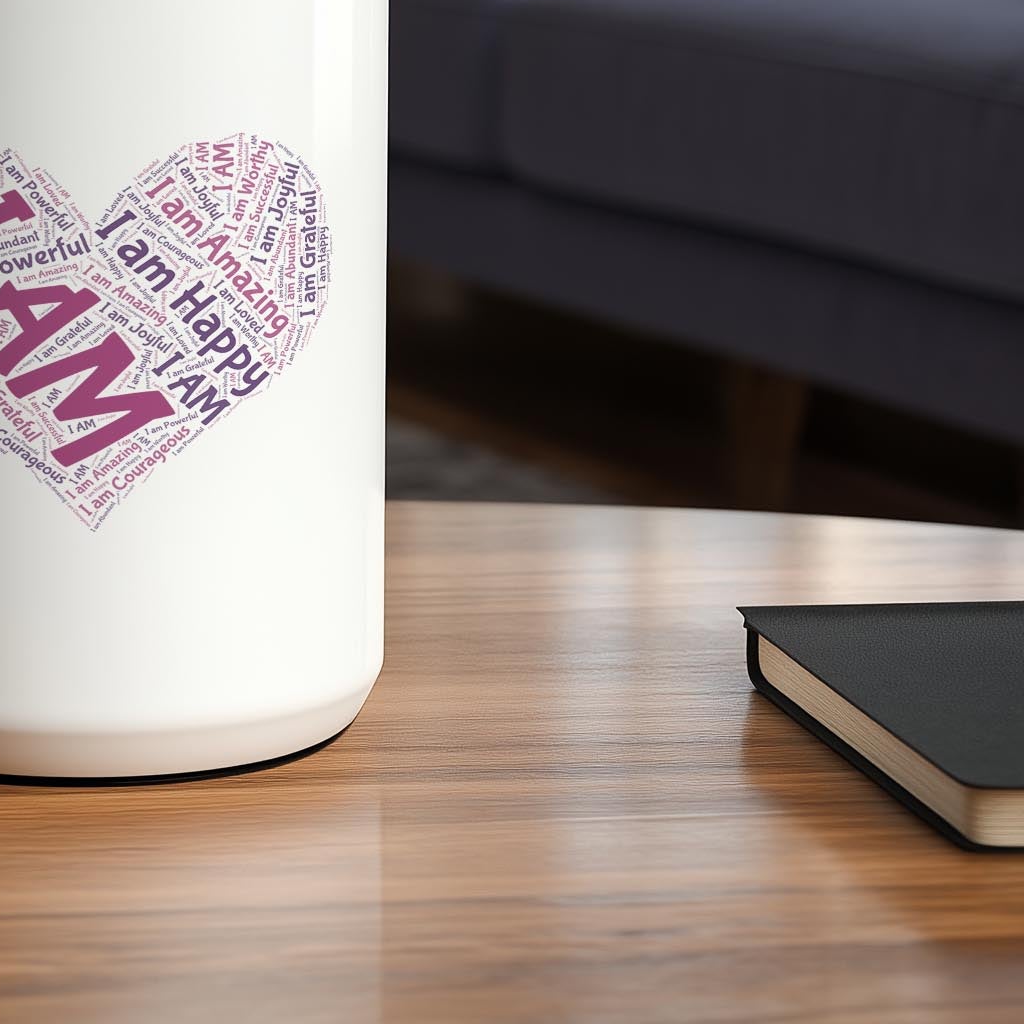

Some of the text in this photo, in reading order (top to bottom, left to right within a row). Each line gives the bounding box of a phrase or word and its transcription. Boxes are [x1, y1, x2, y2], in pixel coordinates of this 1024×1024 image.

[195, 141, 209, 163] AM
[212, 143, 234, 177] AM
[0, 156, 12, 165] I
[6, 165, 25, 183] am
[22, 180, 75, 231] Powerful
[35, 173, 46, 184] am
[43, 183, 64, 207] Loved
[175, 157, 225, 221] I am Joyful
[223, 141, 274, 232] I am Worthy
[249, 164, 279, 222] Successful
[268, 162, 300, 222] Joyful
[100, 213, 110, 223] am
[105, 192, 125, 213] Loved
[127, 192, 141, 205] am
[139, 204, 166, 227] Joyful
[290, 200, 297, 215] AM
[2, 222, 33, 235] Powerful
[244, 224, 257, 242] am
[260, 226, 279, 252] am
[298, 190, 317, 268] Grateful
[318, 226, 329, 263] Happy
[137, 222, 205, 269] I am Courageous
[145, 176, 289, 338] I am Amazing
[250, 255, 267, 265] I
[285, 223, 297, 279] Abundant
[16, 263, 79, 284] I am Amazing
[304, 274, 316, 303] am
[319, 265, 326, 282] am
[82, 265, 168, 327] I am Amazing
[95, 209, 270, 396] I am Happy
[213, 280, 265, 334] I am Loved
[288, 283, 296, 300] am
[99, 302, 174, 353] I am Joyful
[300, 309, 316, 317] I
[33, 316, 93, 363] I am Grateful
[168, 326, 178, 336] am
[175, 334, 193, 355] Loved
[232, 318, 242, 328] am
[241, 326, 259, 348] Worthy
[257, 344, 266, 352] I
[172, 369, 185, 377] am
[186, 356, 215, 372] Grateful
[260, 352, 277, 369] AM
[46, 388, 62, 403] AM
[151, 351, 231, 425] I AM
[67, 419, 96, 434] I AM
[163, 411, 199, 429] Powerful
[65, 490, 76, 500] I
[75, 479, 94, 494] am
[92, 441, 142, 481] Amazing
[74, 464, 90, 480] AM
[78, 504, 92, 516] I
[91, 490, 116, 509] am
[111, 426, 190, 490] Courageous
